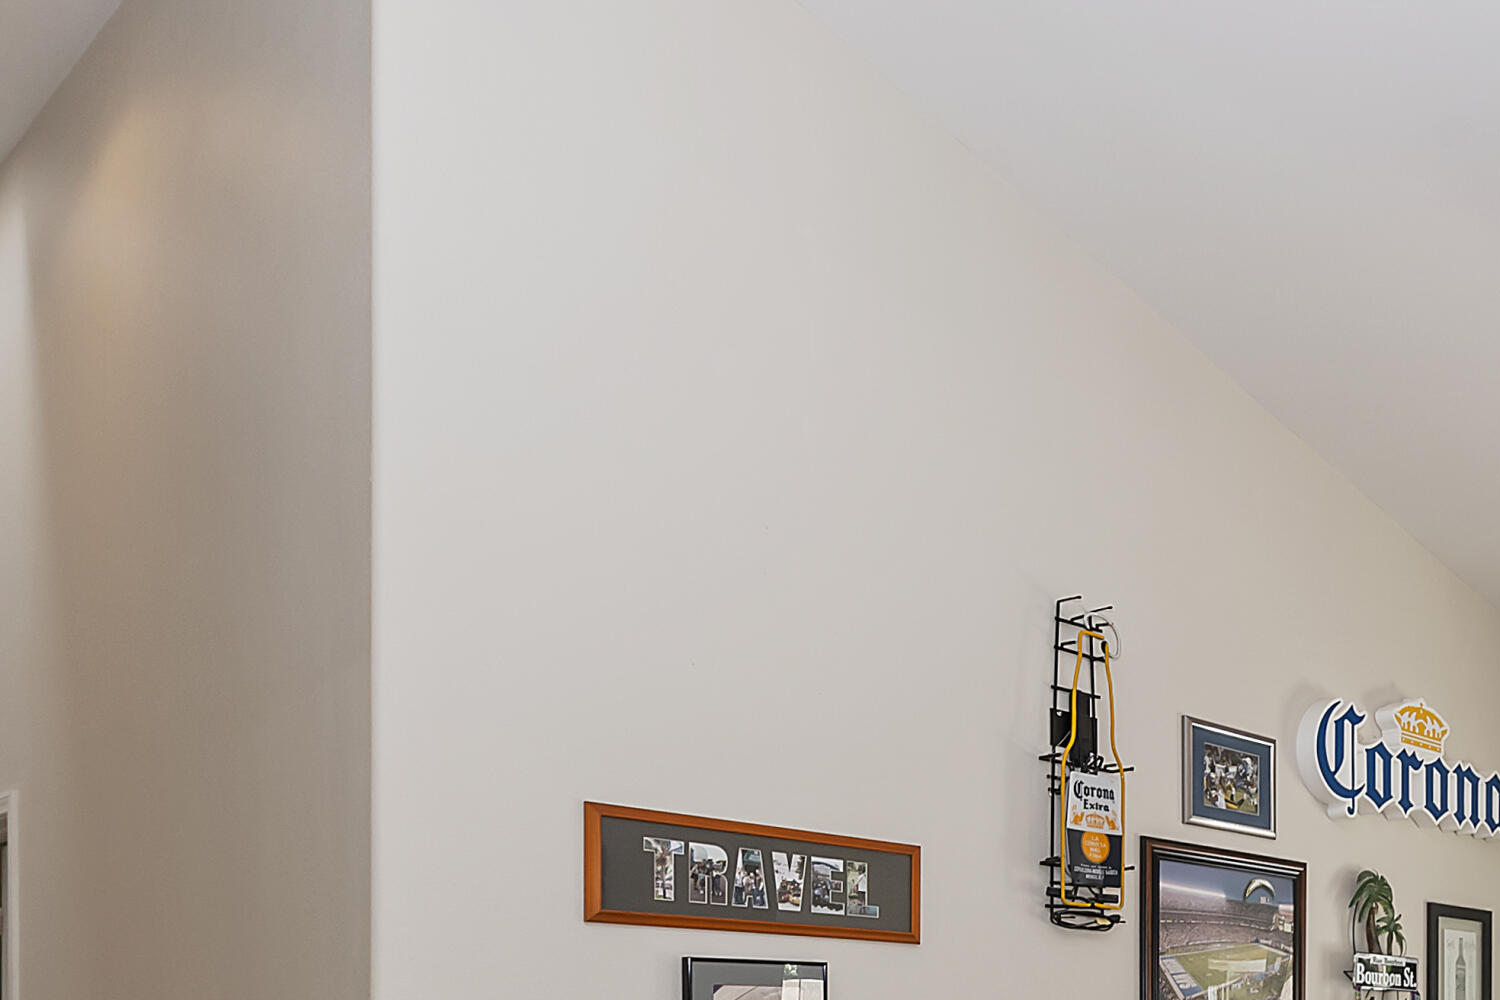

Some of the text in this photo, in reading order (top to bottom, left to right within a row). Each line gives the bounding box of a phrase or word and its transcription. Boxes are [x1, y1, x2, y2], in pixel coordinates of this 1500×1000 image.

[1073, 780, 1115, 804] Corona
[1083, 798, 1110, 812] Extra
[643, 836, 880, 919] TRAVEL
[1356, 962, 1417, 988] Bourbon St.
